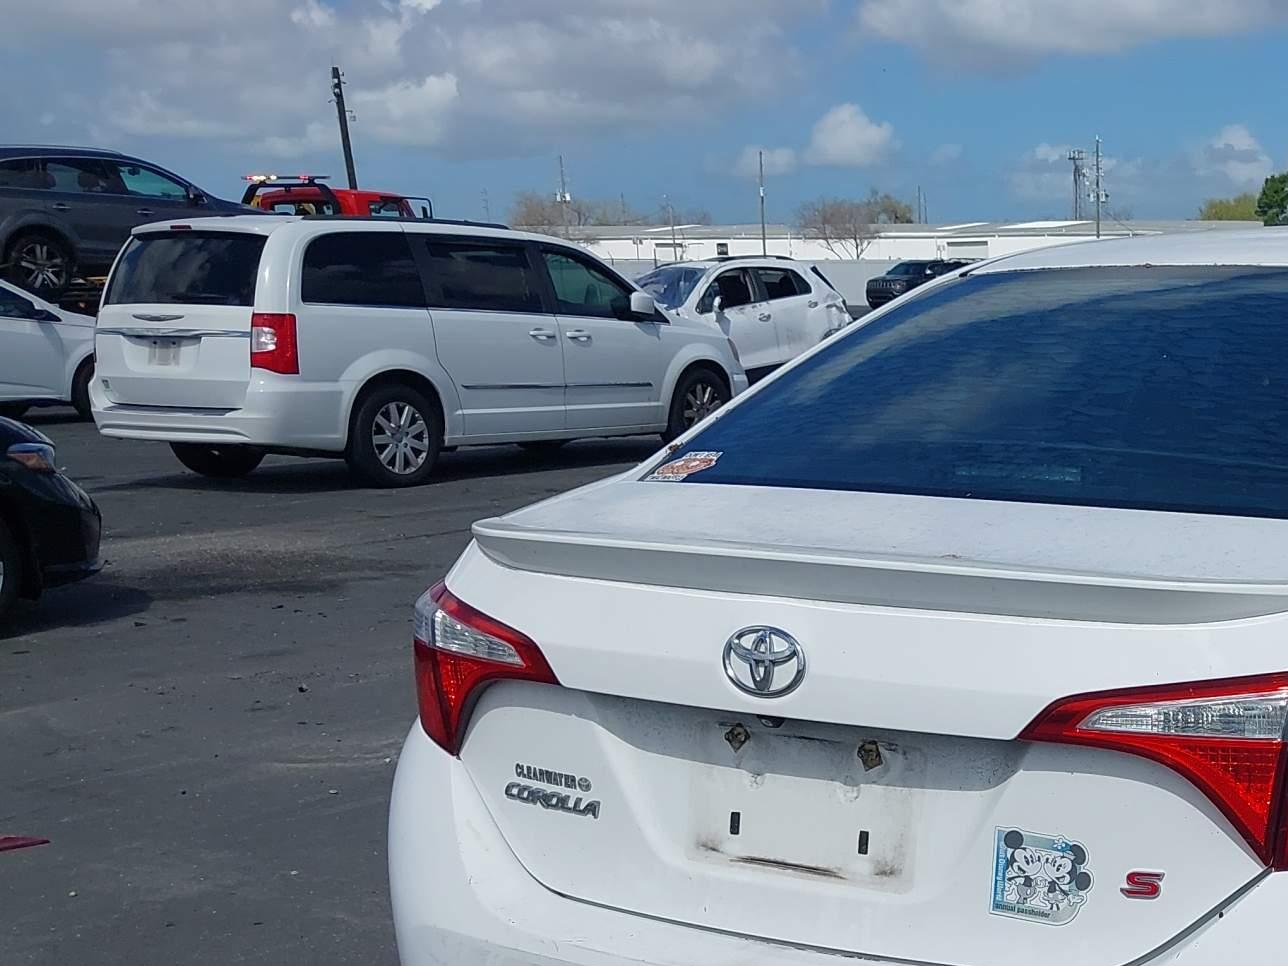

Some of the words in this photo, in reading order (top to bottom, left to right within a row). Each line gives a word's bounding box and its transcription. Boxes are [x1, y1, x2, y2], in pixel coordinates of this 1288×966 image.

[514, 762, 578, 791] CLEARWATER
[504, 781, 601, 820] COROLLA
[1119, 870, 1166, 900] S
[994, 903, 1016, 913] annual
[1016, 907, 1051, 919] passholder
